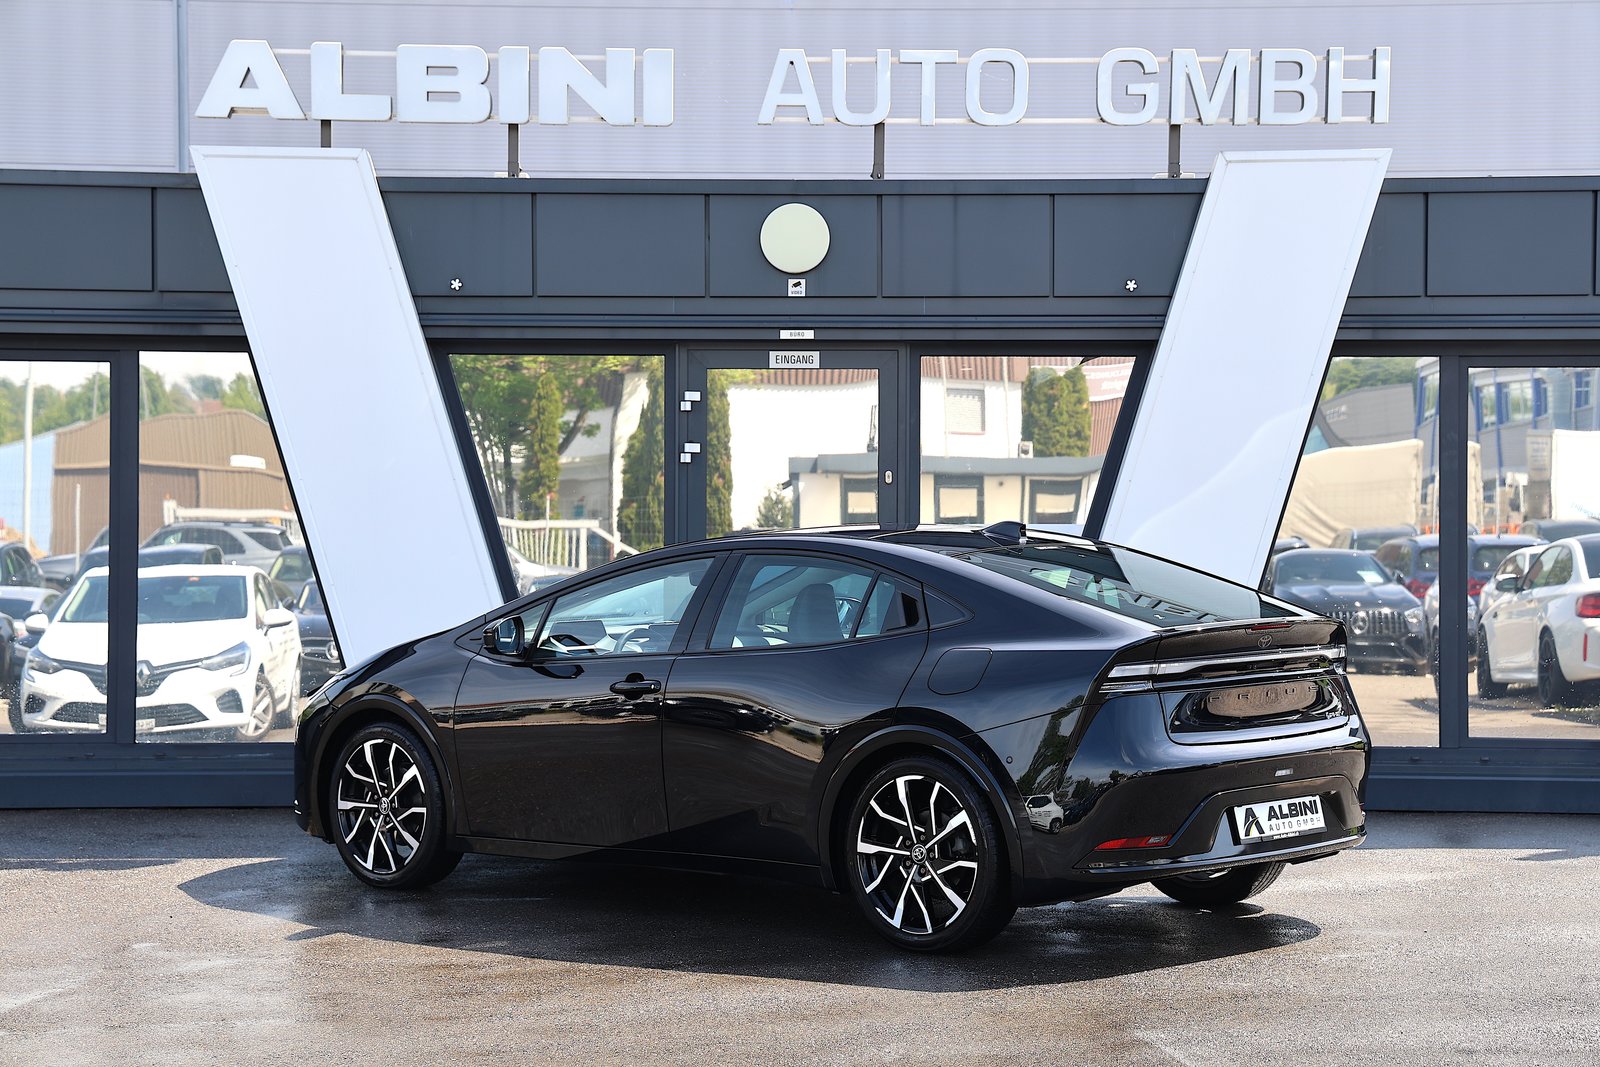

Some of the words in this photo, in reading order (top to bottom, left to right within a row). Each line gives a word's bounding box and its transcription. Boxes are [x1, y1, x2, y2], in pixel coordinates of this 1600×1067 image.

[194, 39, 675, 127] ALBINI
[757, 47, 1030, 127] AUTO
[1096, 46, 1391, 126] GMBH
[775, 354, 814, 364] EINGANG
[1267, 799, 1319, 821] ALBINI
[1269, 820, 1293, 832] AUTO
